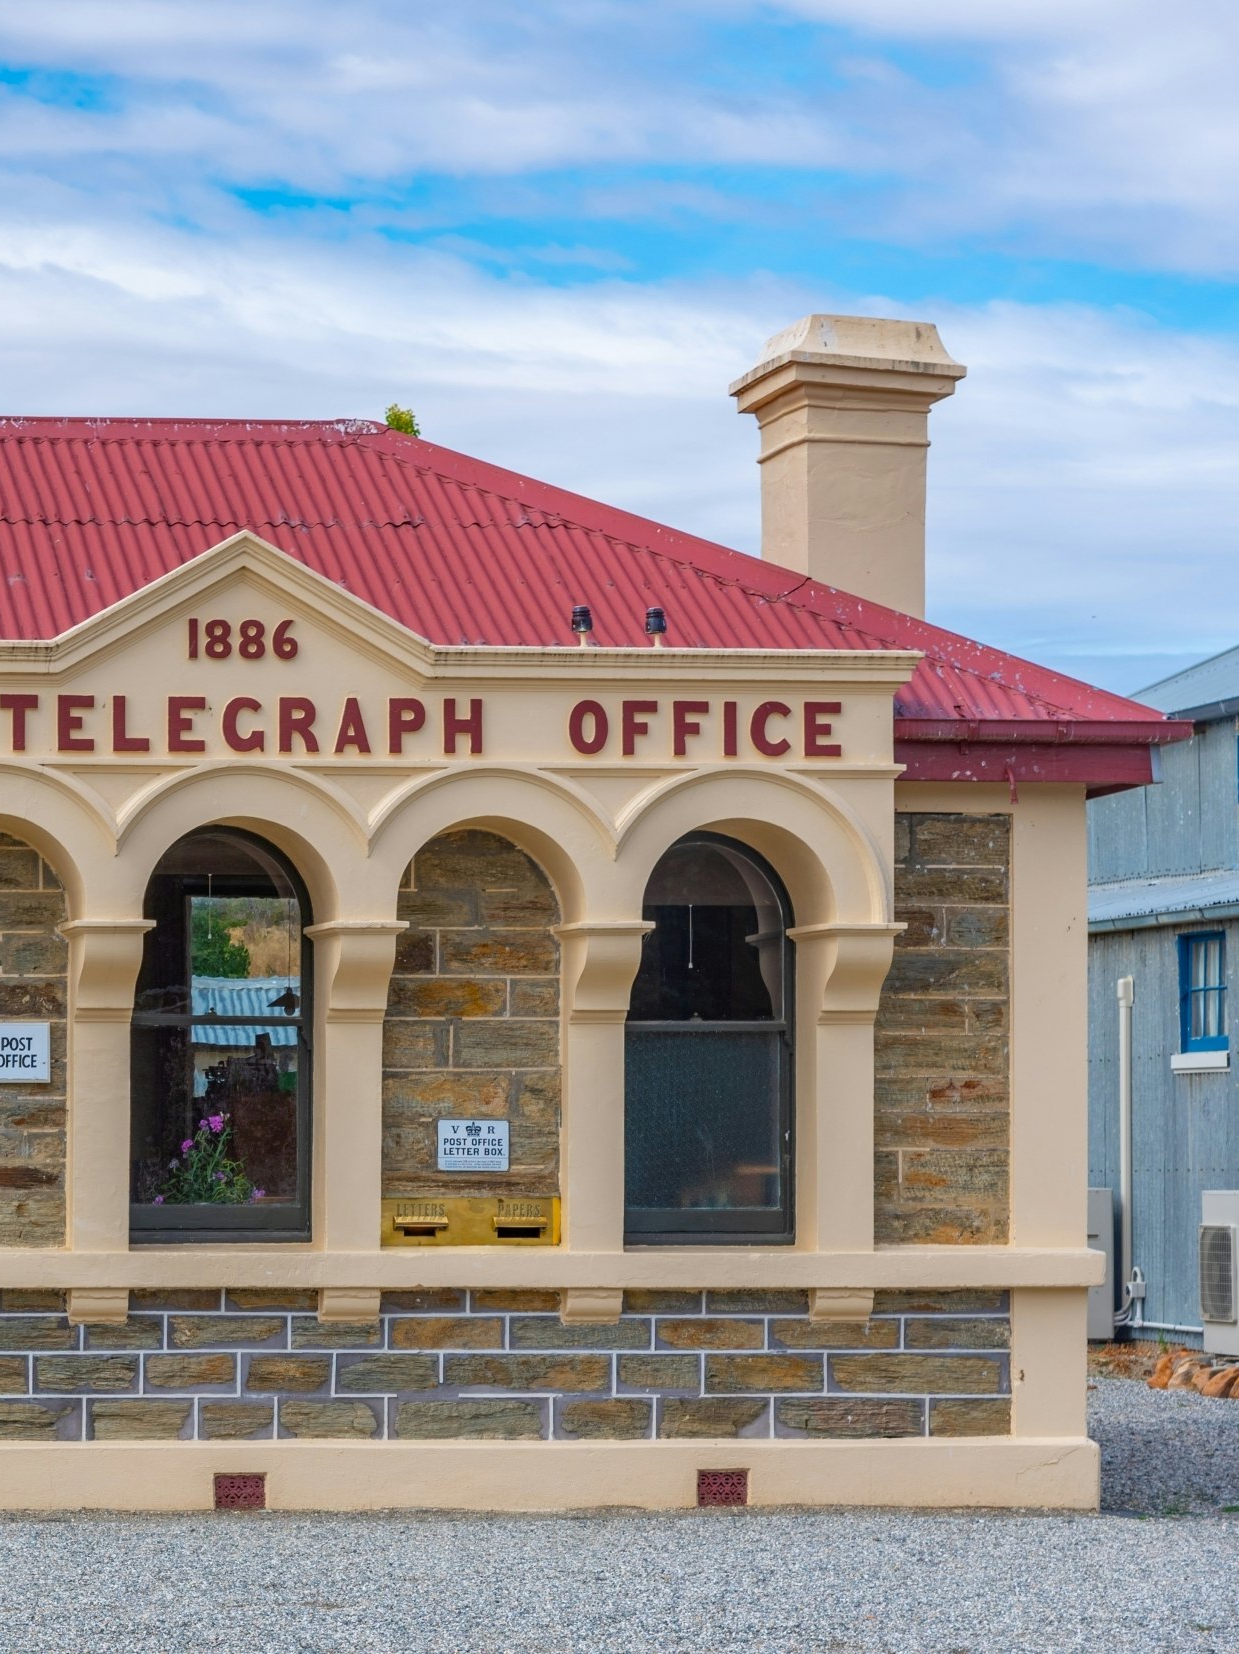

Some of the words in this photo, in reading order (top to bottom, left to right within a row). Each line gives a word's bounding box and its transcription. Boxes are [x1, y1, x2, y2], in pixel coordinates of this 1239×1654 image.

[189, 618, 299, 660] 1886
[0, 694, 483, 756] TELEGRAPH
[568, 700, 843, 758] OFFICE
[0, 1036, 33, 1052] POST
[451, 1125, 461, 1134] V
[487, 1125, 496, 1135] R
[443, 1137, 468, 1146] POST
[471, 1138, 504, 1147] OFFICE
[443, 1147, 480, 1156] LETTER
[396, 1203, 446, 1217] LETTERS
[497, 1203, 541, 1217] PAPERS
